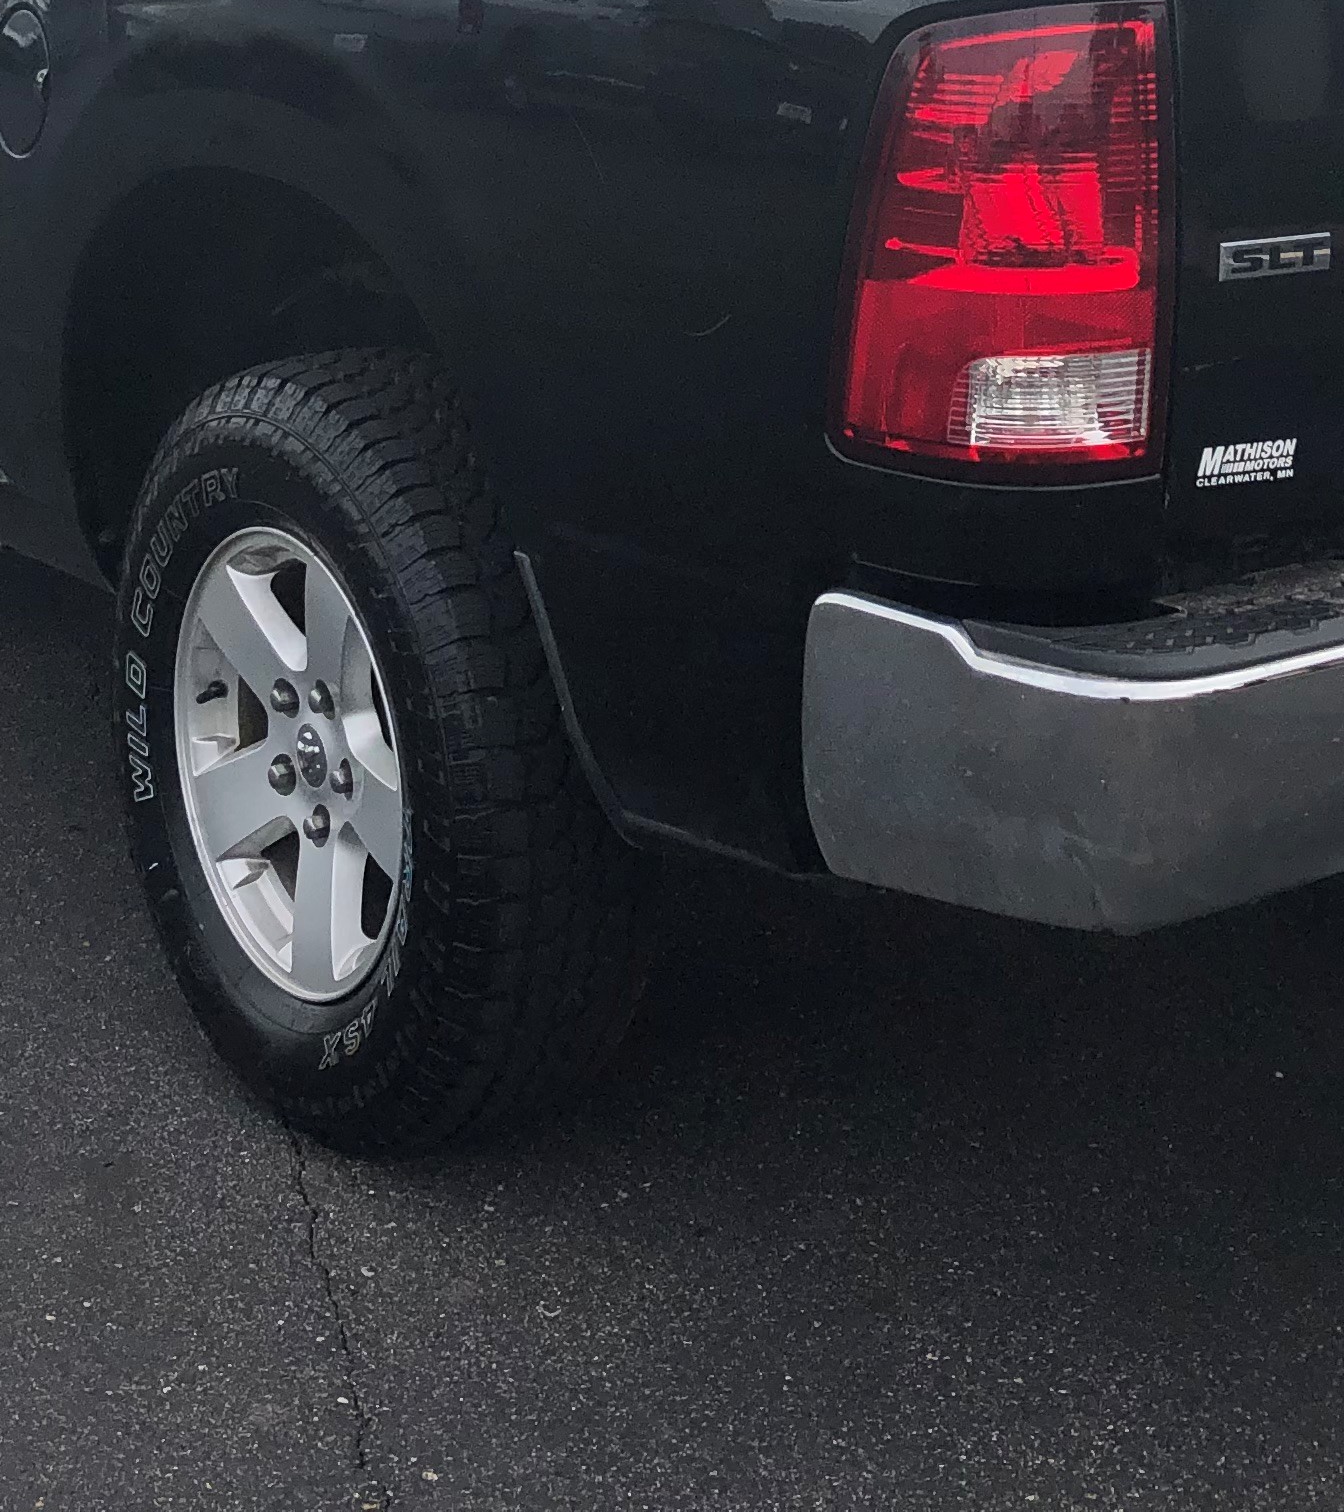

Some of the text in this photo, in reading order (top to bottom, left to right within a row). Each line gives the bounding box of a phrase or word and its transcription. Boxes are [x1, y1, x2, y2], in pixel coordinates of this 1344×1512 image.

[1229, 240, 1326, 275] SLT
[1197, 438, 1297, 477] MATHISON
[1244, 456, 1294, 472] MOTORS
[1196, 469, 1294, 488] CLEARWATER, MN
[126, 467, 239, 803] WILD COUNTRY
